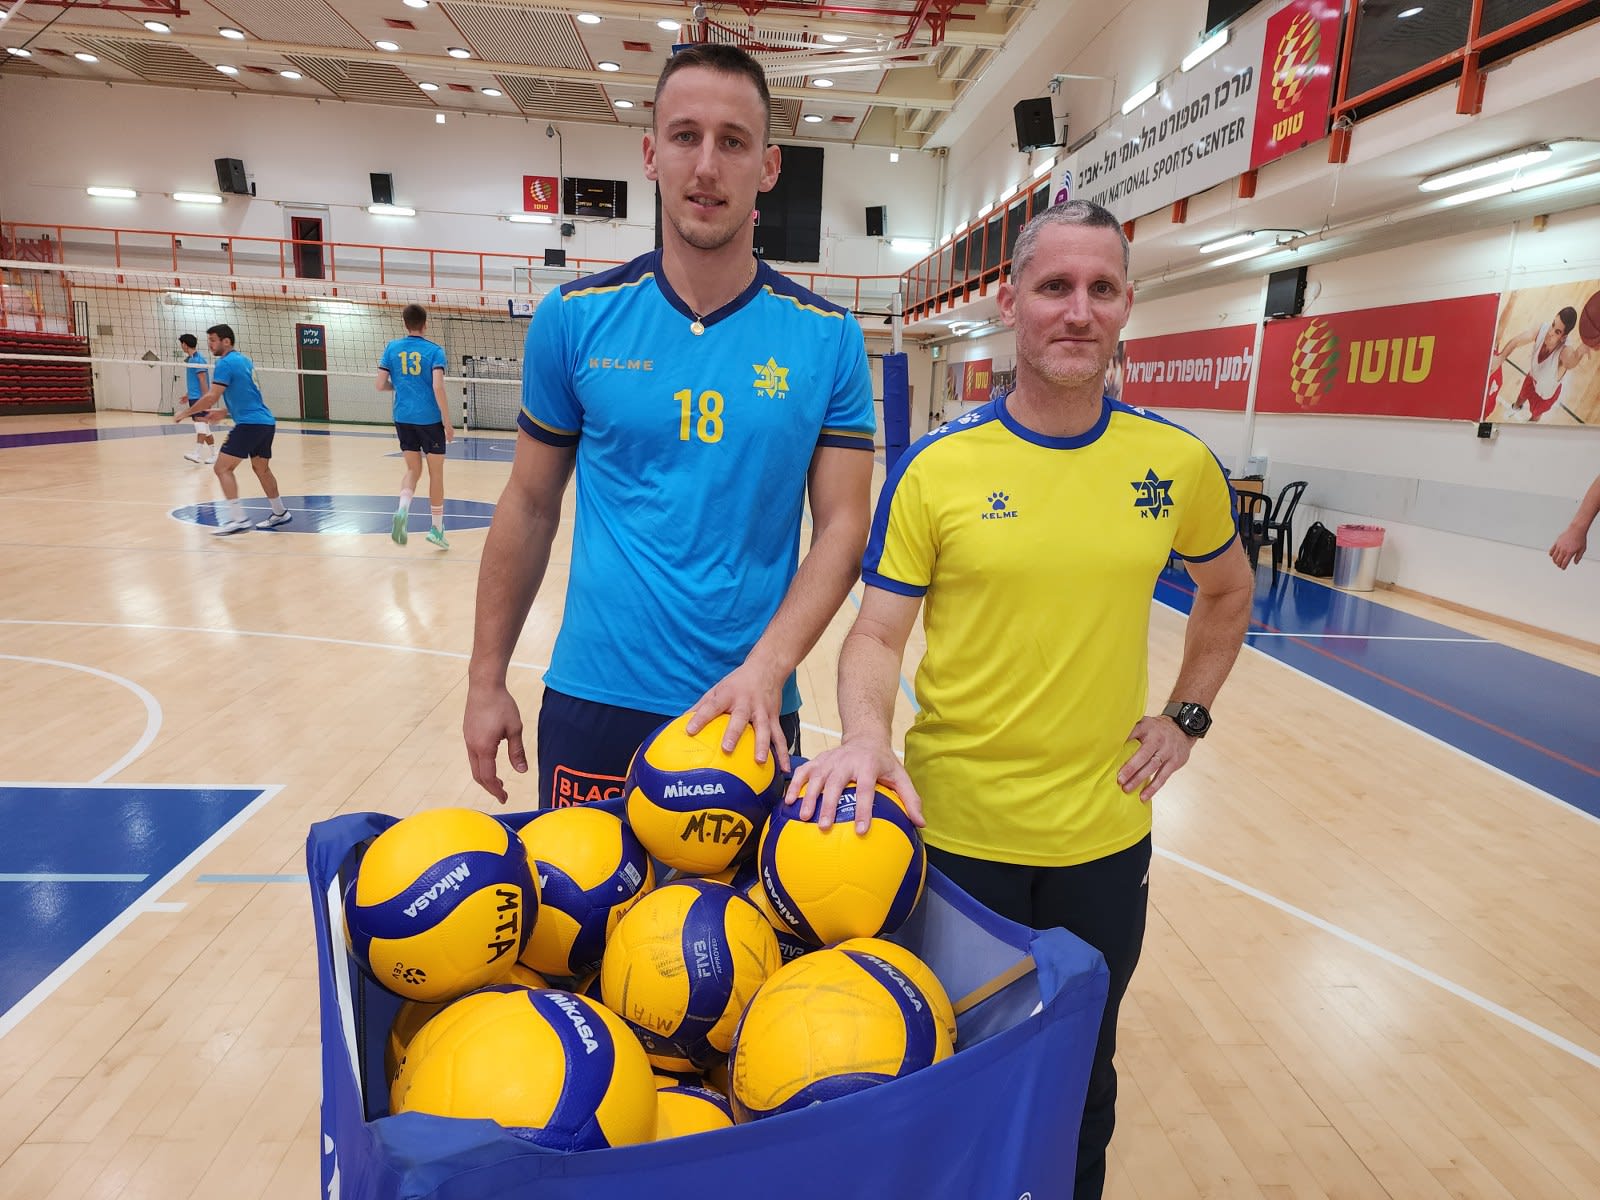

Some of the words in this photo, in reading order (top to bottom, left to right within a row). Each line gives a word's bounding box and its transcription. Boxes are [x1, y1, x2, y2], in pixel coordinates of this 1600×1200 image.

[1213, 66, 1253, 109] מרכז
[1159, 93, 1210, 141] הספורט
[1272, 111, 1304, 145] טוטו
[1109, 167, 1150, 204] NATIONAL
[1152, 143, 1194, 182] SPORTS
[1197, 117, 1245, 159] CENTER
[1119, 126, 1156, 164] הלאומי
[1078, 150, 1116, 189] תל-אביב
[397, 351, 422, 376] 13
[589, 357, 654, 371] KELME
[1126, 356, 1166, 384] בישראל
[1167, 358, 1214, 383] הספורט
[1214, 346, 1253, 390] למען
[1347, 335, 1436, 384] טוטו
[673, 388, 725, 444] 18
[981, 510, 1019, 520] KELME
[560, 777, 626, 801] BLAC
[838, 793, 857, 805] FIV
[392, 961, 404, 980] CEV
[711, 937, 723, 974] APPROVED
